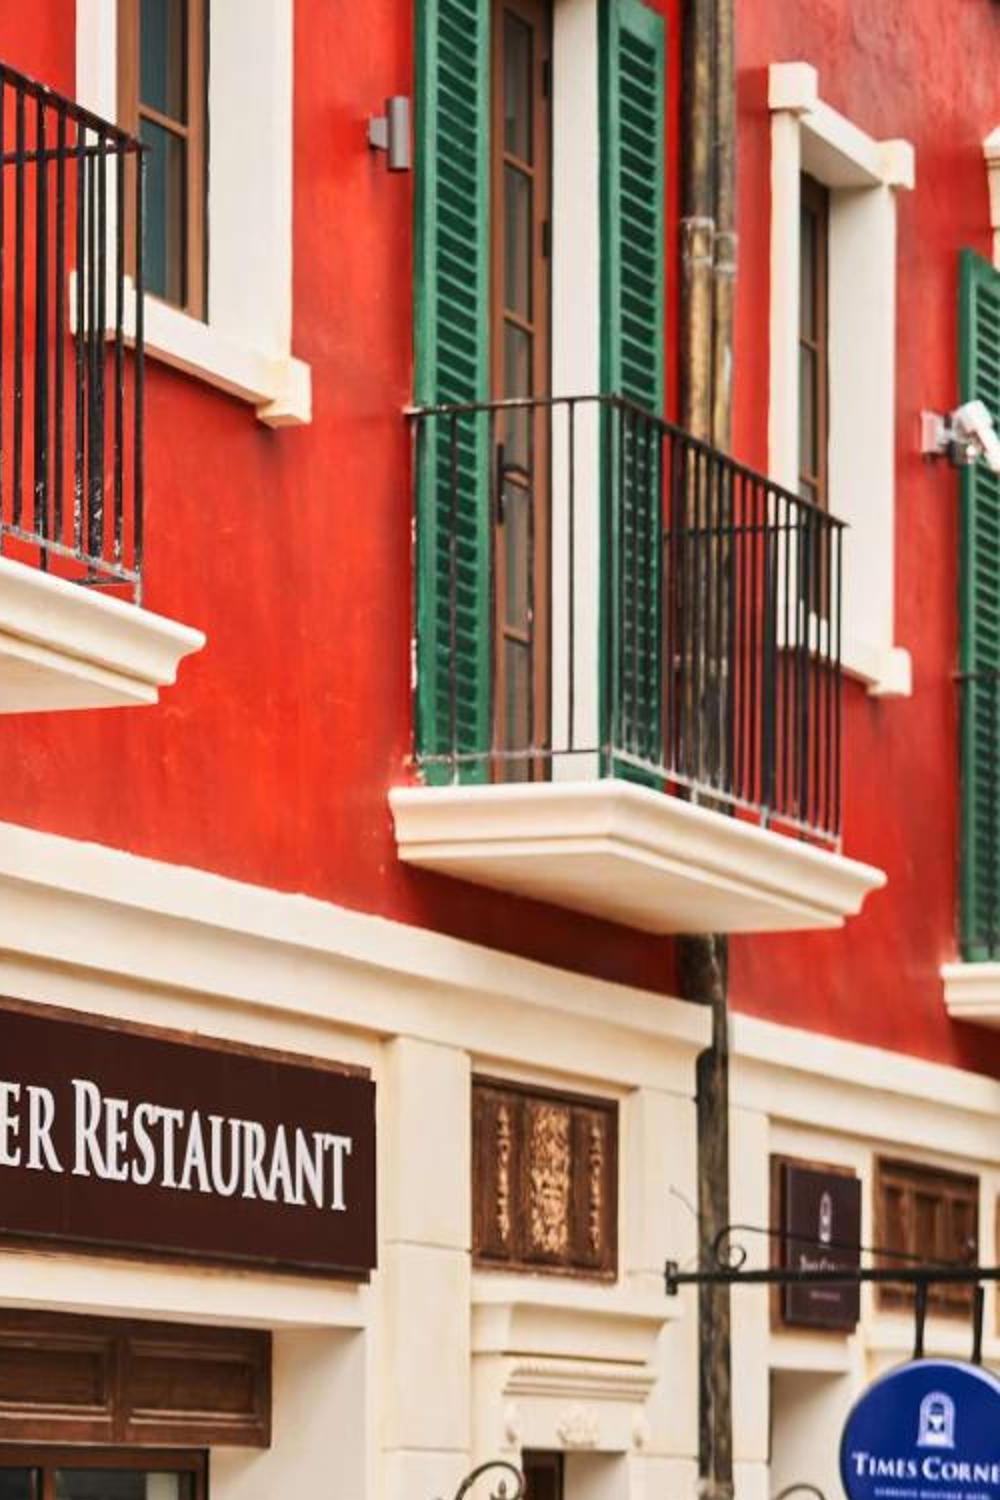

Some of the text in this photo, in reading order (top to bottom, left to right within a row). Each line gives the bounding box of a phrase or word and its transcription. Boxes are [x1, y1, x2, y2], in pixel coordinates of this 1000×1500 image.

[72, 1078, 352, 1211] RESTAURANT
[852, 1452, 1000, 1484] TIMES CORNE
